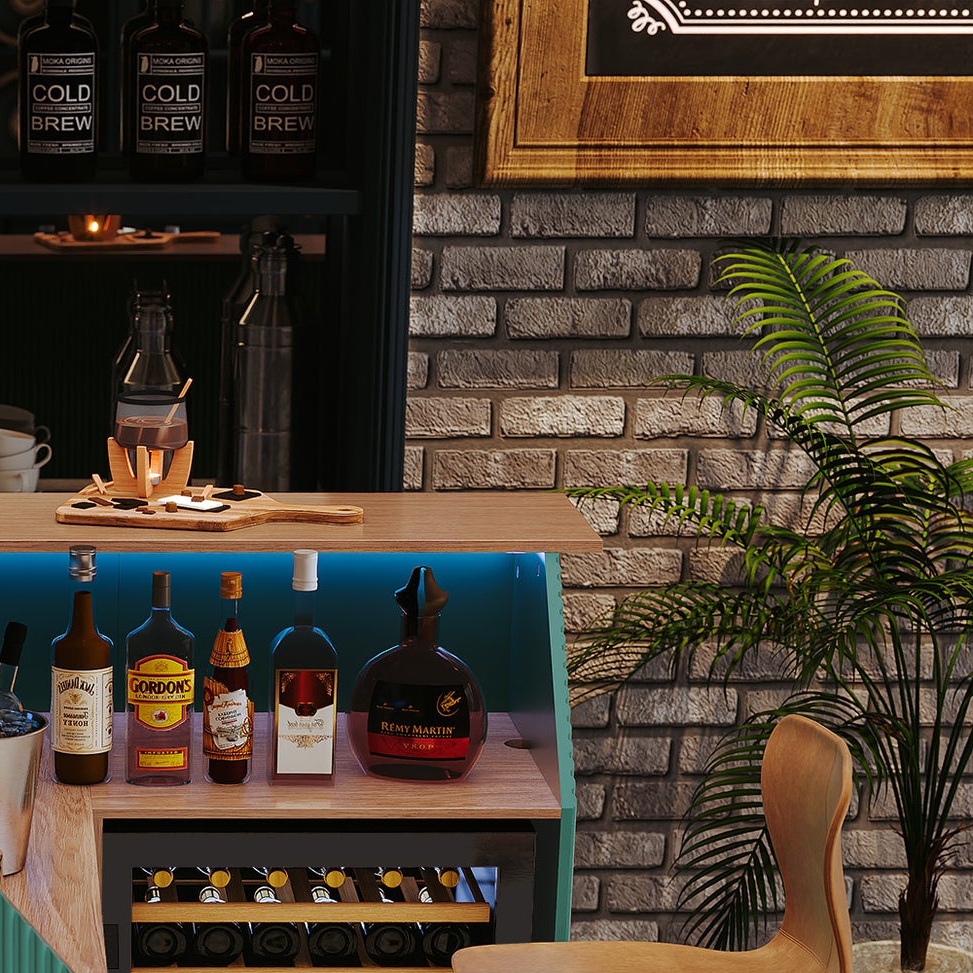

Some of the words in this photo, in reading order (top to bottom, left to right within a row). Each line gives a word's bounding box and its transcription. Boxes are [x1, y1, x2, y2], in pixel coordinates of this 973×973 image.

[43, 57, 64, 65] MOKA
[153, 57, 174, 65] MOKA
[33, 84, 90, 102] COLD
[143, 84, 200, 102] COLD
[256, 84, 313, 102] COLD
[32, 115, 92, 131] BREW
[141, 115, 201, 131] BREW
[254, 115, 314, 131] BREW
[129, 677, 192, 694] GORDON'S
[381, 721, 410, 733] RÉMY
[412, 724, 453, 735] MARTIN
